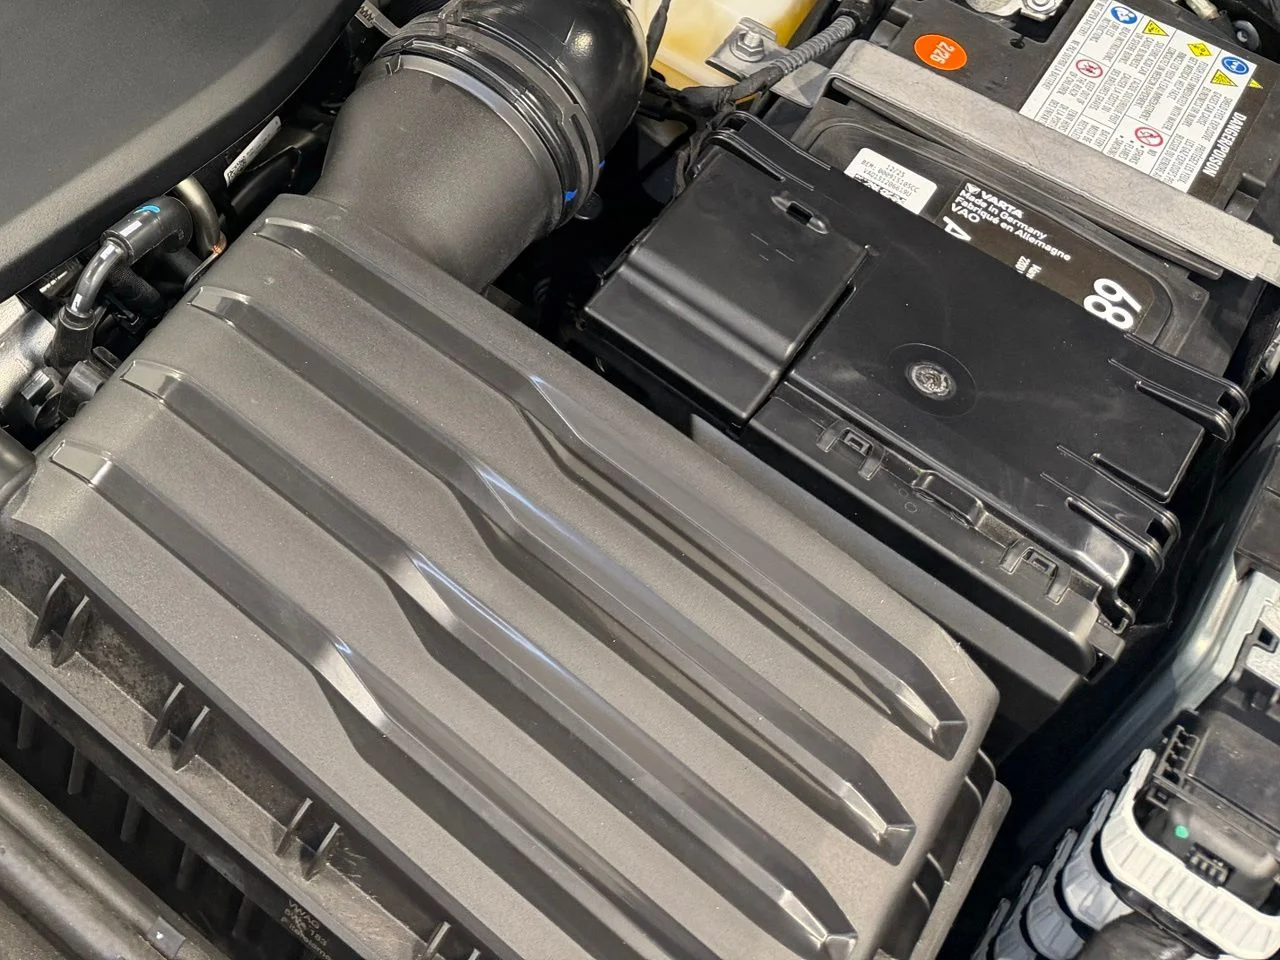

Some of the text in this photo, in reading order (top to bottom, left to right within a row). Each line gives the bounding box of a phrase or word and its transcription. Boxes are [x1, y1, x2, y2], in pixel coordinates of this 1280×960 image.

[930, 41, 955, 64] 2/26
[1199, 109, 1248, 177] DANGER/POISON
[948, 202, 981, 224] VAO
[953, 195, 1072, 263] Fabriqué en Allemagne
[958, 189, 1048, 242] Made in Germany
[978, 190, 1025, 219] VARTA
[1083, 278, 1142, 330] 68
